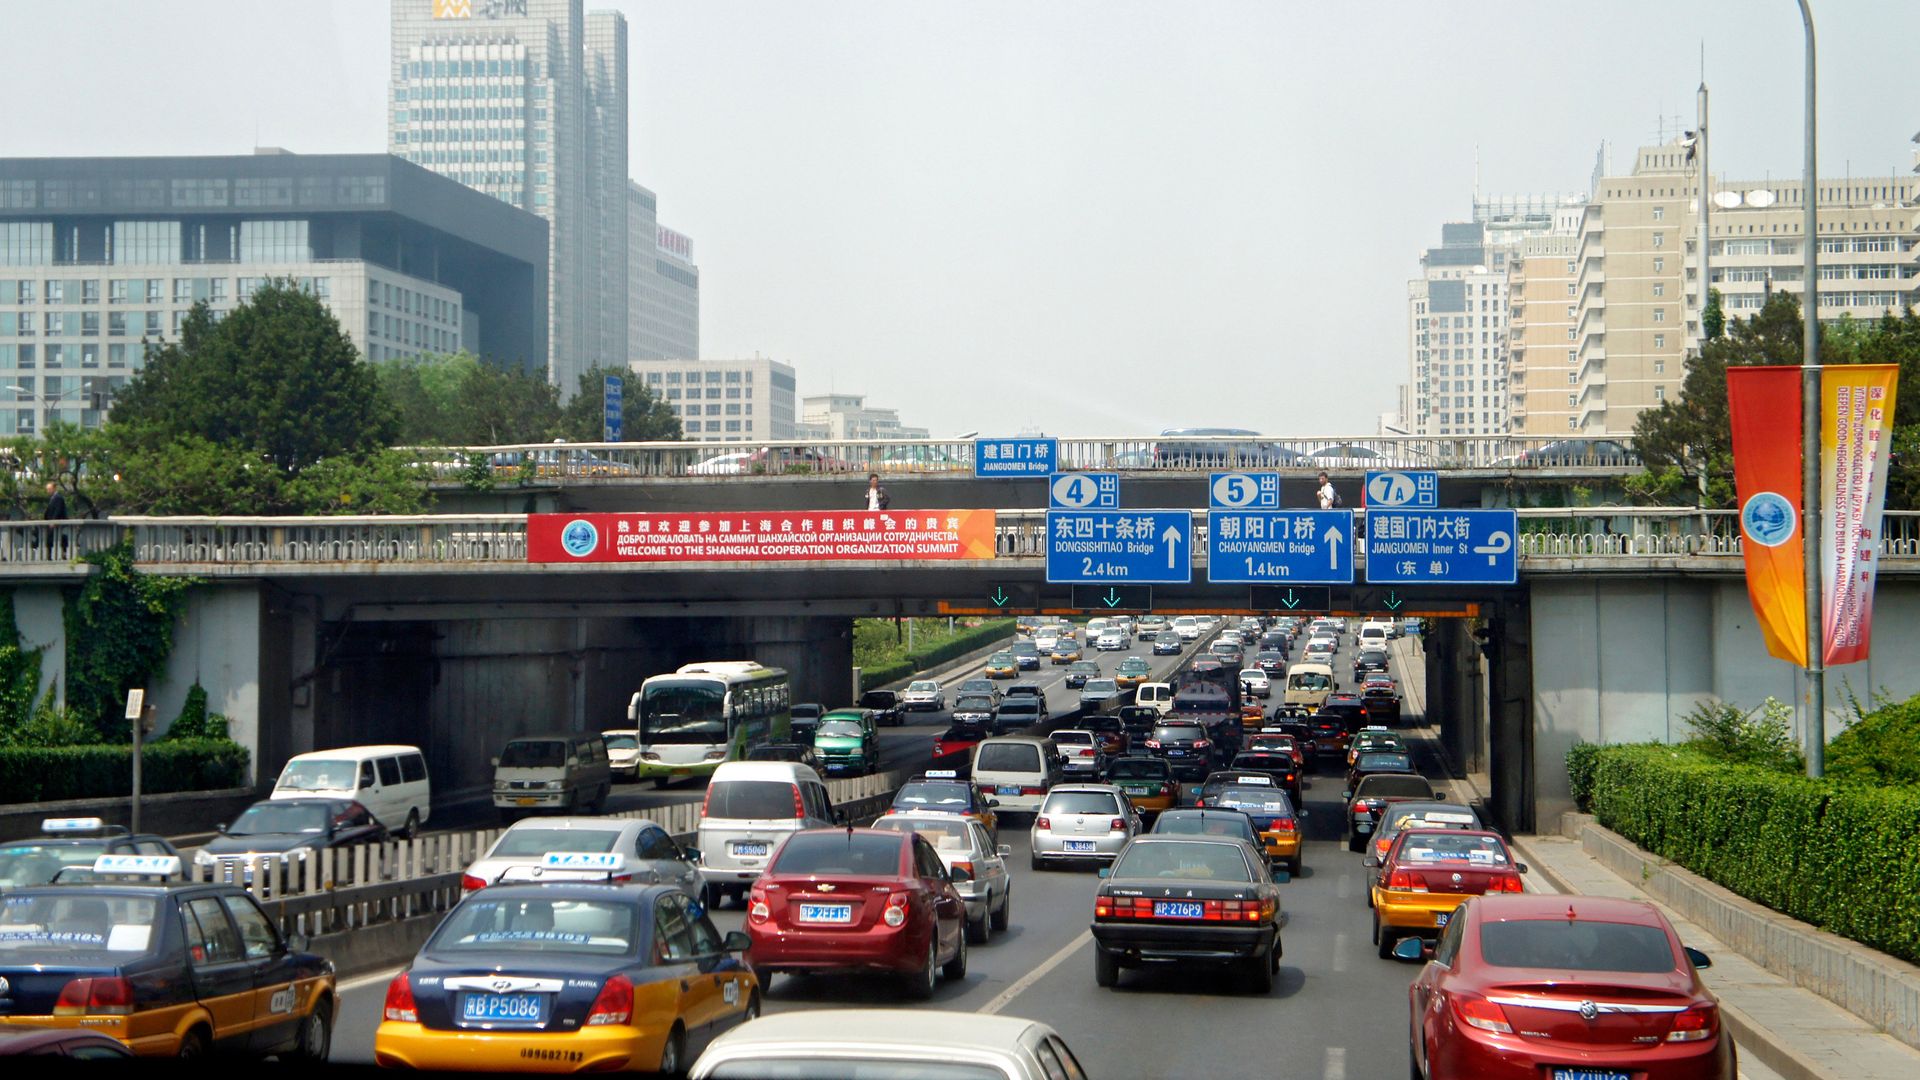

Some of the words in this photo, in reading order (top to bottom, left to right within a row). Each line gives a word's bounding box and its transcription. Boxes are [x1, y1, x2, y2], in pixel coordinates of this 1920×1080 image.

[1838, 387, 1848, 416] DEEPEN
[983, 444, 1049, 459] 建国门桥
[983, 462, 1026, 471] JIANGUOMEN
[1028, 462, 1049, 471] Bridge
[1066, 478, 1084, 503] 4
[1100, 476, 1115, 506] 出口
[1227, 478, 1245, 503] 5
[1261, 476, 1276, 505] 出口
[1380, 477, 1404, 501] 7A
[1418, 475, 1434, 504] 出口
[1054, 516, 1156, 540] 东四十条桥
[1219, 516, 1316, 540] 朝阳门桥
[1373, 516, 1471, 540] 建国门内大街
[1836, 511, 1847, 528] AND
[617, 534, 647, 546] ДОБРО
[647, 533, 704, 545] ПОЖАЛОВАТЬ
[705, 534, 718, 544] НА
[719, 533, 757, 544] САММИТ
[757, 530, 817, 544] ШАНХАЙСКОЙ
[819, 531, 882, 544] ОРГАНИЗАЦИИ
[883, 530, 959, 543] СОТРУДНИЧЕСТВА
[617, 546, 667, 556] WELCOME
[669, 546, 683, 556] TO
[685, 546, 704, 555] THE
[705, 546, 759, 555] SHANGHAI
[761, 544, 833, 555] COOPERATION
[835, 544, 914, 554] ORGANIZATION
[916, 543, 959, 553] SUMMIT
[1055, 541, 1123, 553] DONGSISHITIAO
[1127, 541, 1154, 555] Bridge
[1218, 541, 1285, 553] CHAOYANGMEN
[1289, 541, 1315, 555] Bridge
[1372, 542, 1429, 554] JIANGUOMEN
[1432, 543, 1454, 554] Inner
[1458, 543, 1469, 554] St
[1835, 530, 1846, 553] BUILD
